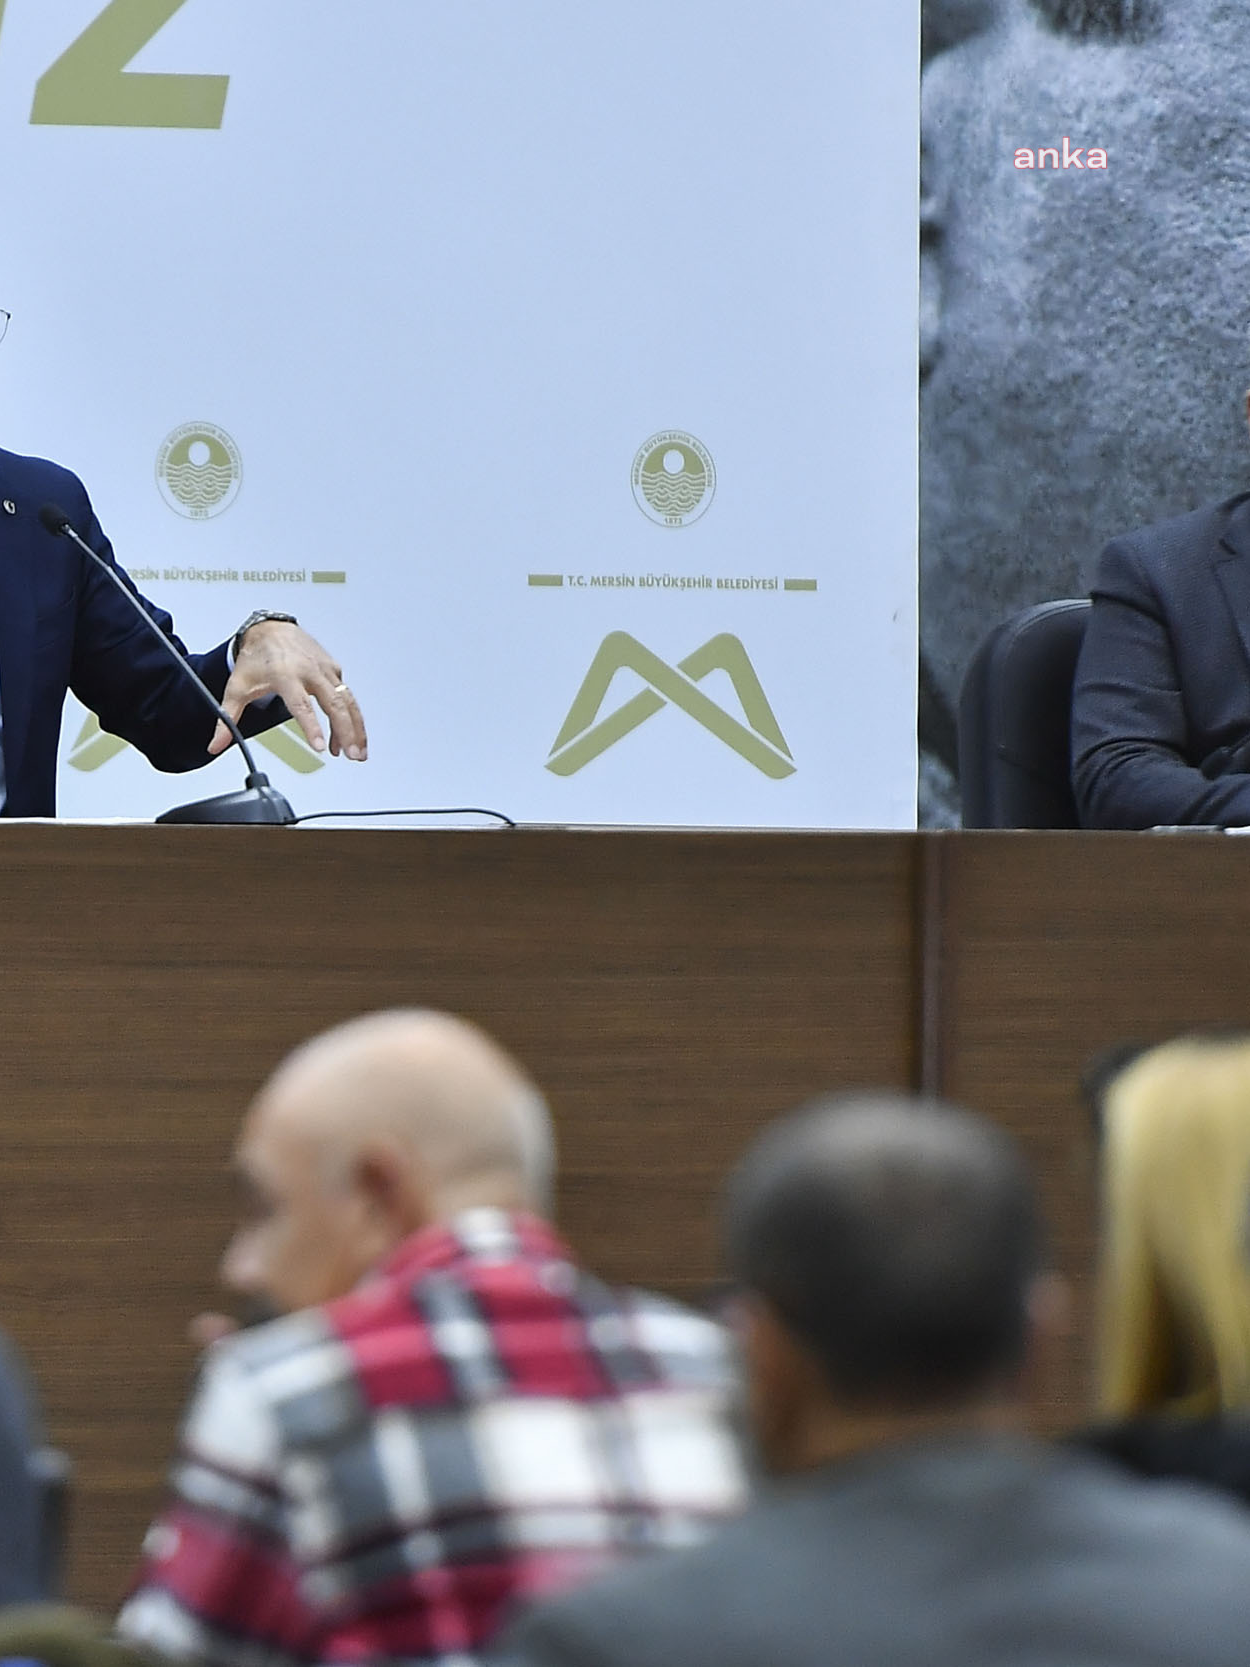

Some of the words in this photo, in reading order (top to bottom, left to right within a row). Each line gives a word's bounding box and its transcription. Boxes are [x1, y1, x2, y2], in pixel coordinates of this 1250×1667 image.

[163, 566, 239, 583] BÜYÜKŞEHİR
[243, 568, 306, 582] BELEDİYESİ
[568, 575, 587, 587] T.C.
[590, 573, 635, 587] MERSİN
[639, 573, 712, 591] BÜYÜKŞEHİR
[716, 576, 778, 590] BELEDİYESİ
